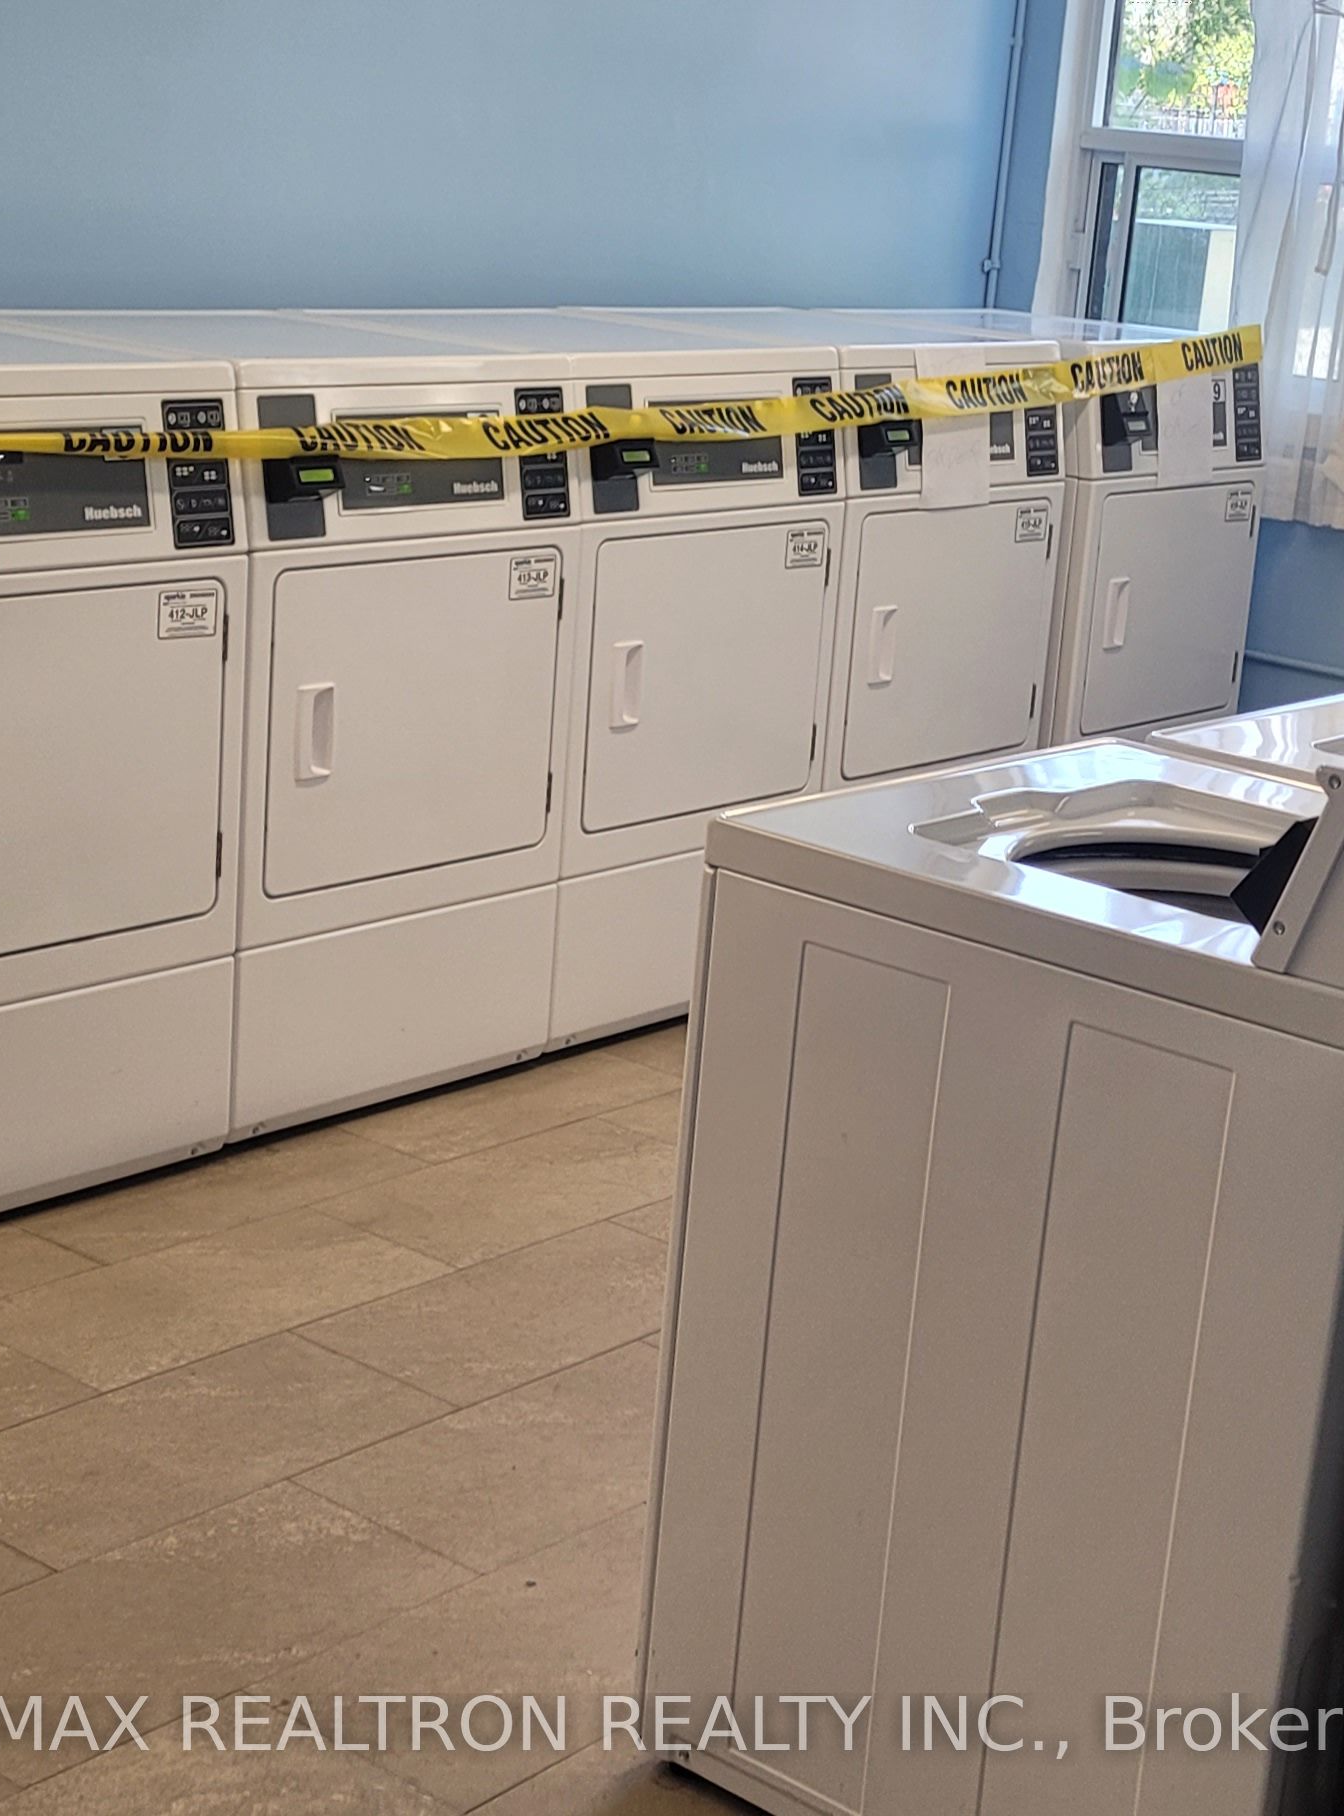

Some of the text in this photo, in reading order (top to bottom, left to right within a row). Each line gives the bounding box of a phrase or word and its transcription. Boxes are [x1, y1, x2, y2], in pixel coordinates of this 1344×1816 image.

[1181, 332, 1244, 372] CAUTION
[1070, 351, 1145, 393] CAUTION
[810, 384, 910, 422] CAUTION
[945, 373, 1029, 410] CAUTION
[1213, 382, 1221, 401] 9
[294, 420, 425, 452] CAUTION
[483, 412, 610, 451] CAUTION
[660, 405, 767, 437] CAUTION
[453, 479, 498, 495] Huebsch
[84, 503, 143, 521] Huebsch
[168, 607, 208, 620] 412-JLP
